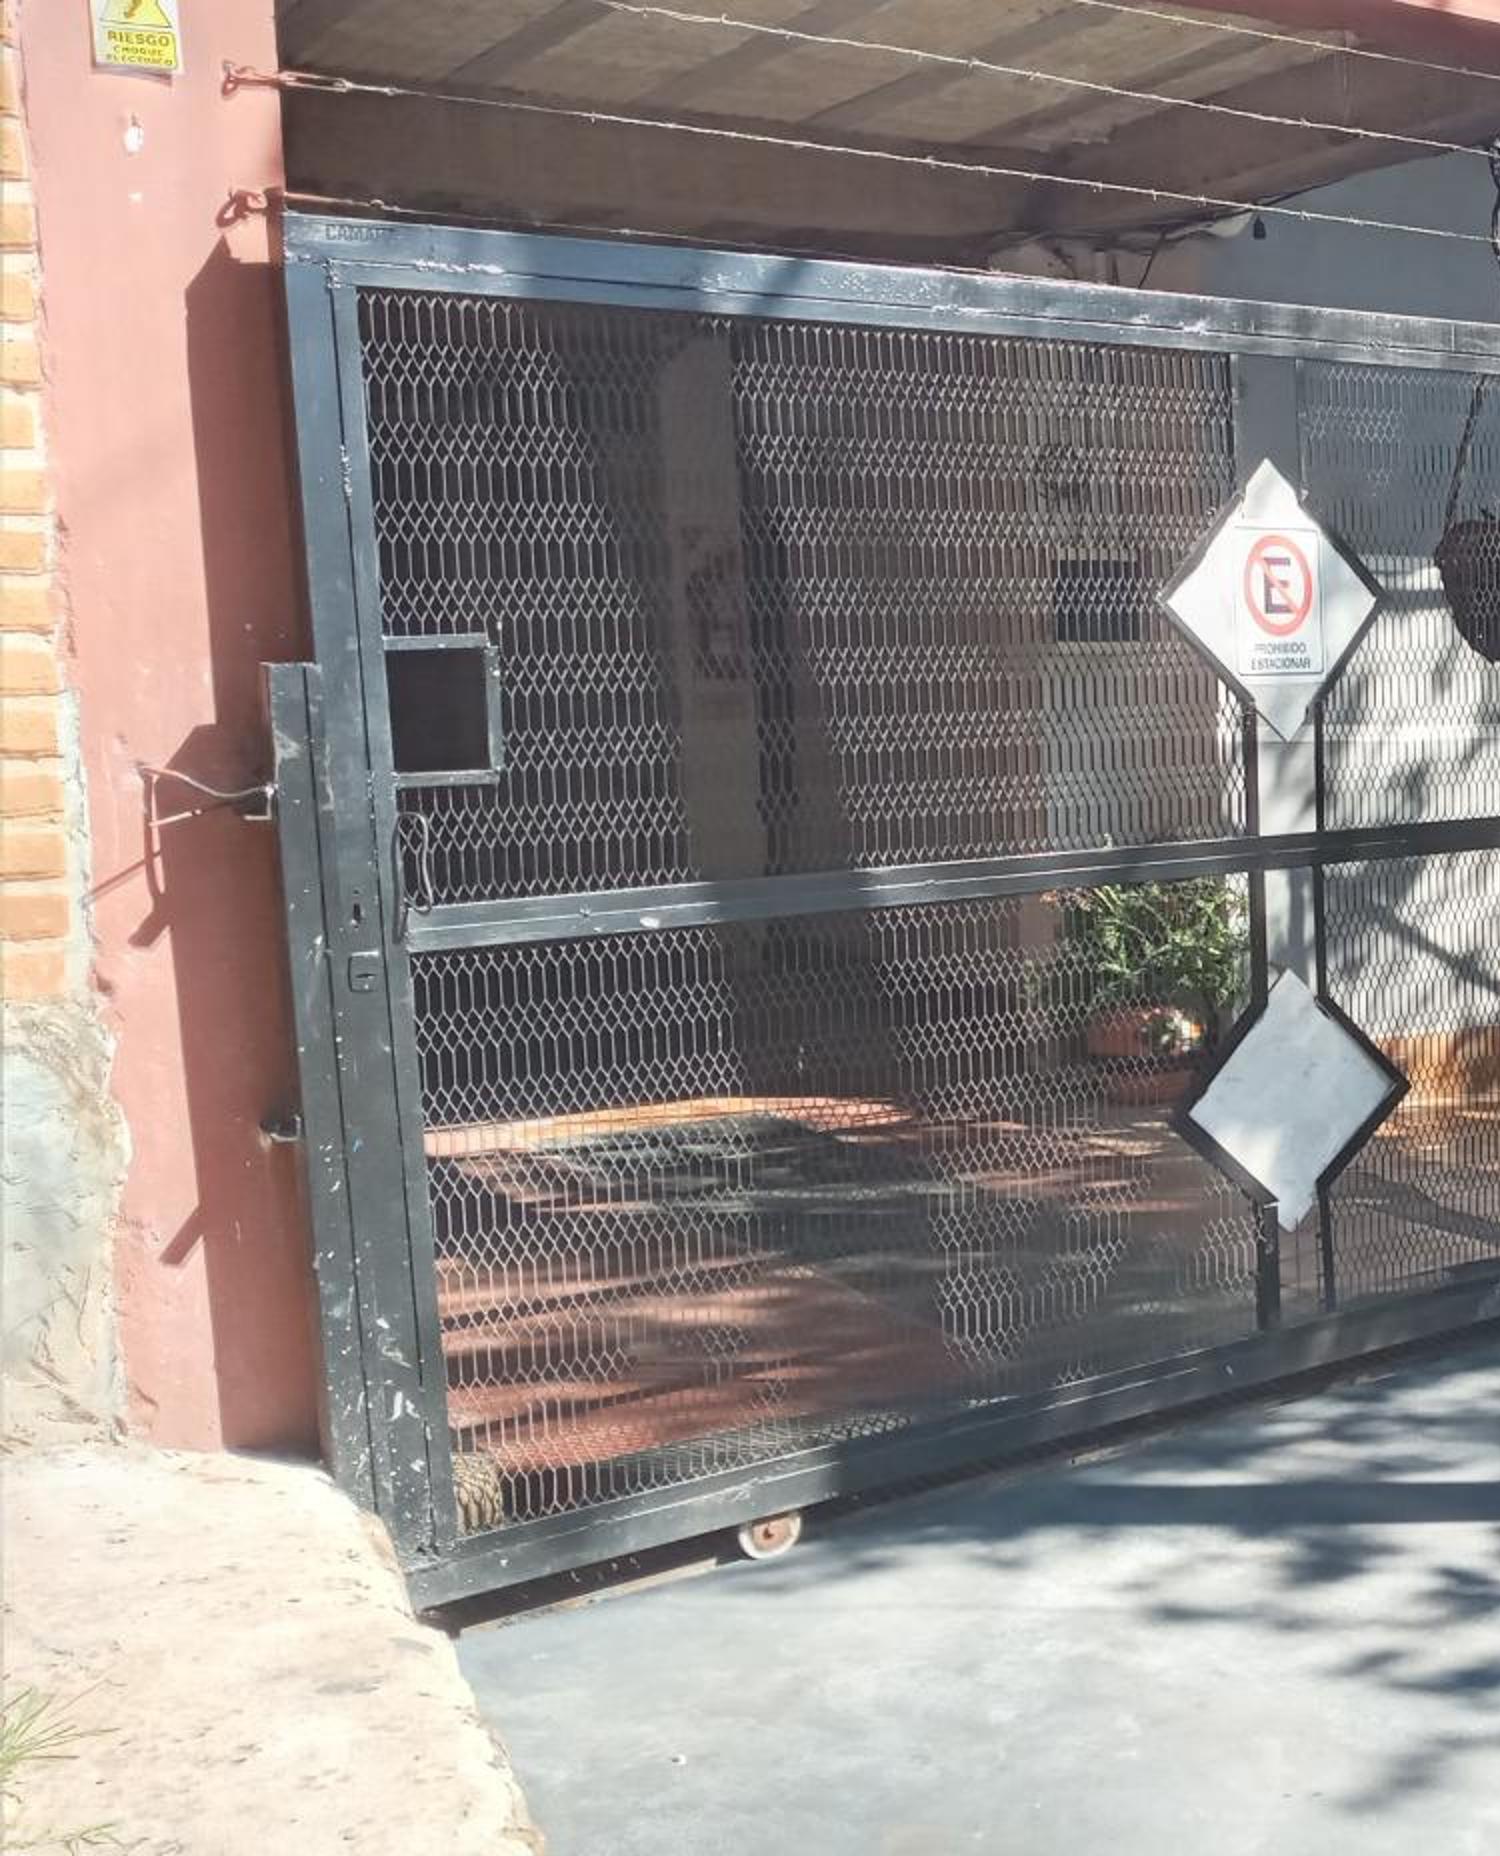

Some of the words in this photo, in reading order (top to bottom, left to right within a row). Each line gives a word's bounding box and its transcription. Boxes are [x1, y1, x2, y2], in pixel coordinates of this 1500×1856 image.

[107, 30, 169, 47] RIESGO
[113, 44, 165, 57] CHOQUE
[1263, 557, 1292, 614] E
[1254, 641, 1307, 655] PROHIBIDO
[1251, 657, 1311, 671] ESTACIONAR
